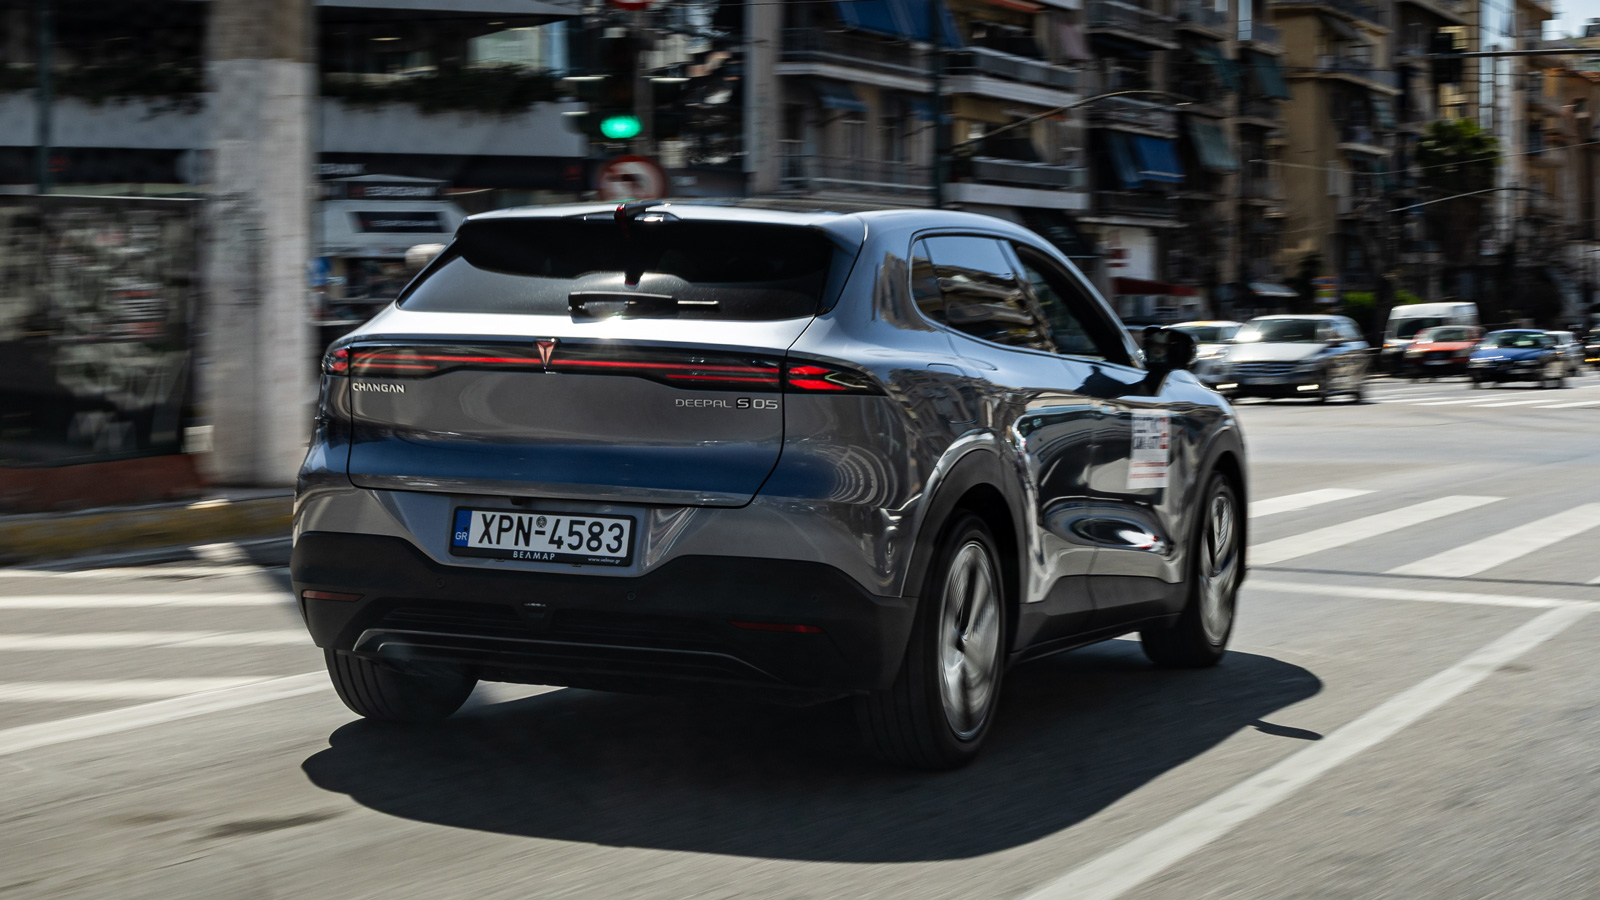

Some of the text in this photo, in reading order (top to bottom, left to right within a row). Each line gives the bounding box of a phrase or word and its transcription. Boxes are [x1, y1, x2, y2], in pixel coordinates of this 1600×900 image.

[352, 382, 405, 393] CHANGAN
[675, 398, 732, 408] DEEPAL
[455, 513, 624, 553] GR XPN-4583
